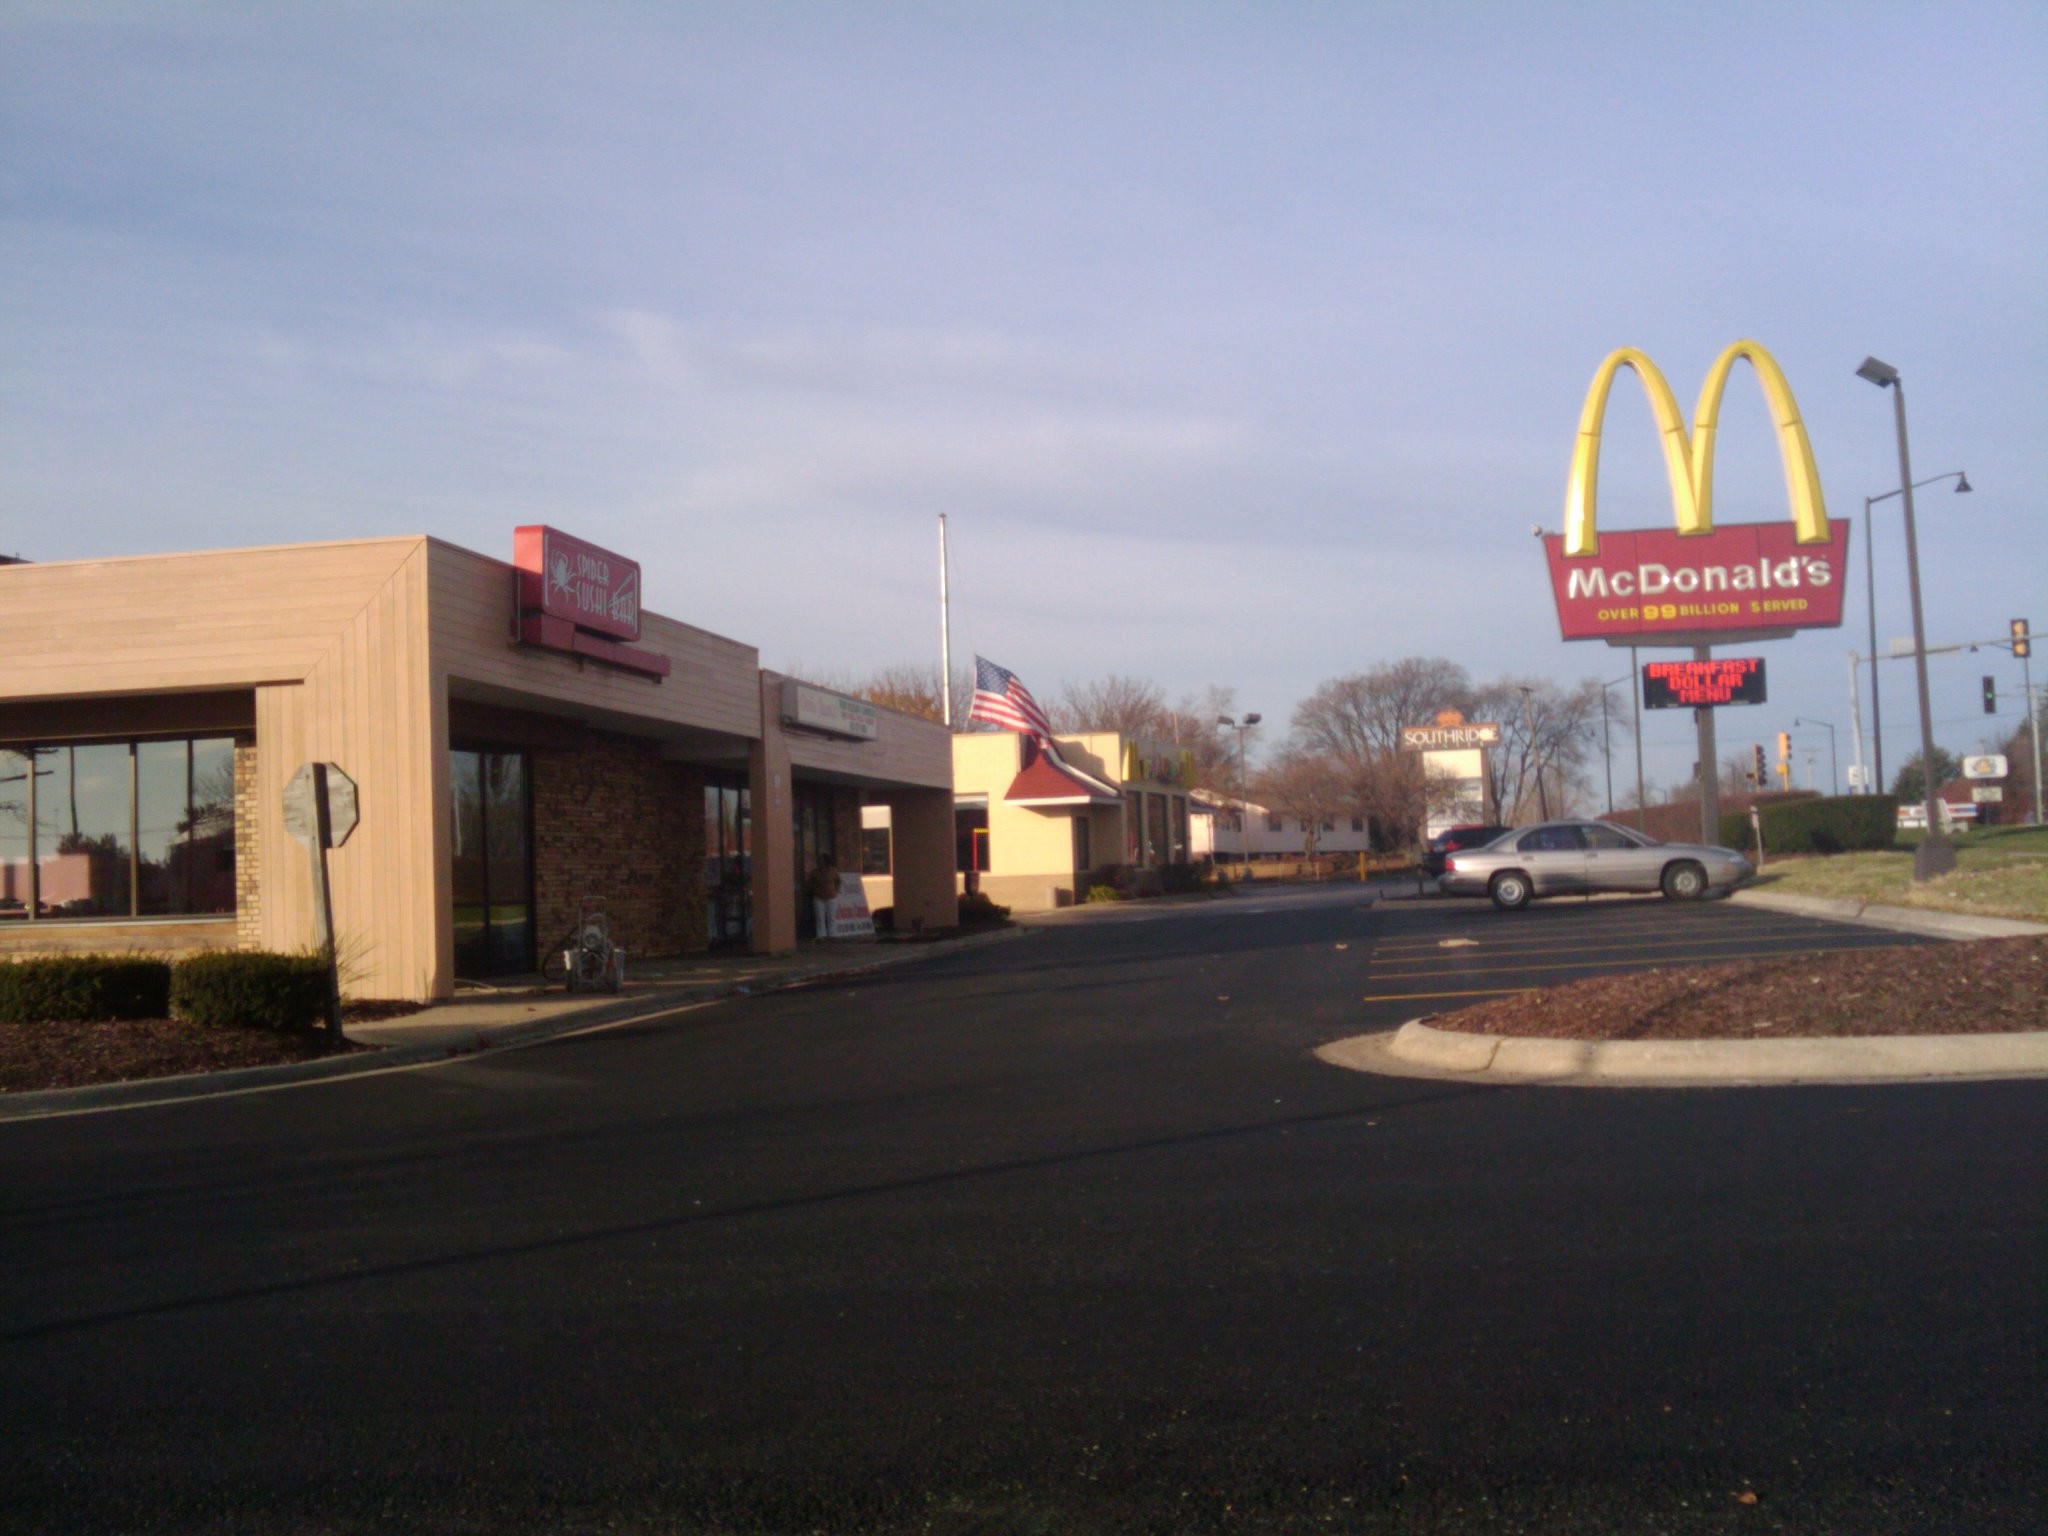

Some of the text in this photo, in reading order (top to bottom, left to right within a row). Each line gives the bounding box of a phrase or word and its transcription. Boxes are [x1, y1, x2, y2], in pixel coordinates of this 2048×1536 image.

[578, 554, 609, 585] SPIDER
[1569, 555, 1831, 598] McDonald's
[577, 582, 607, 616] SUSHI
[1598, 598, 1808, 621] OVER 99 BILLION SERVED
[1649, 659, 1758, 678] BREAKFAST
[1669, 674, 1743, 690] DOLLAR
[1680, 688, 1731, 703] MENU
[1404, 728, 1498, 745] SOUTHRIDE
